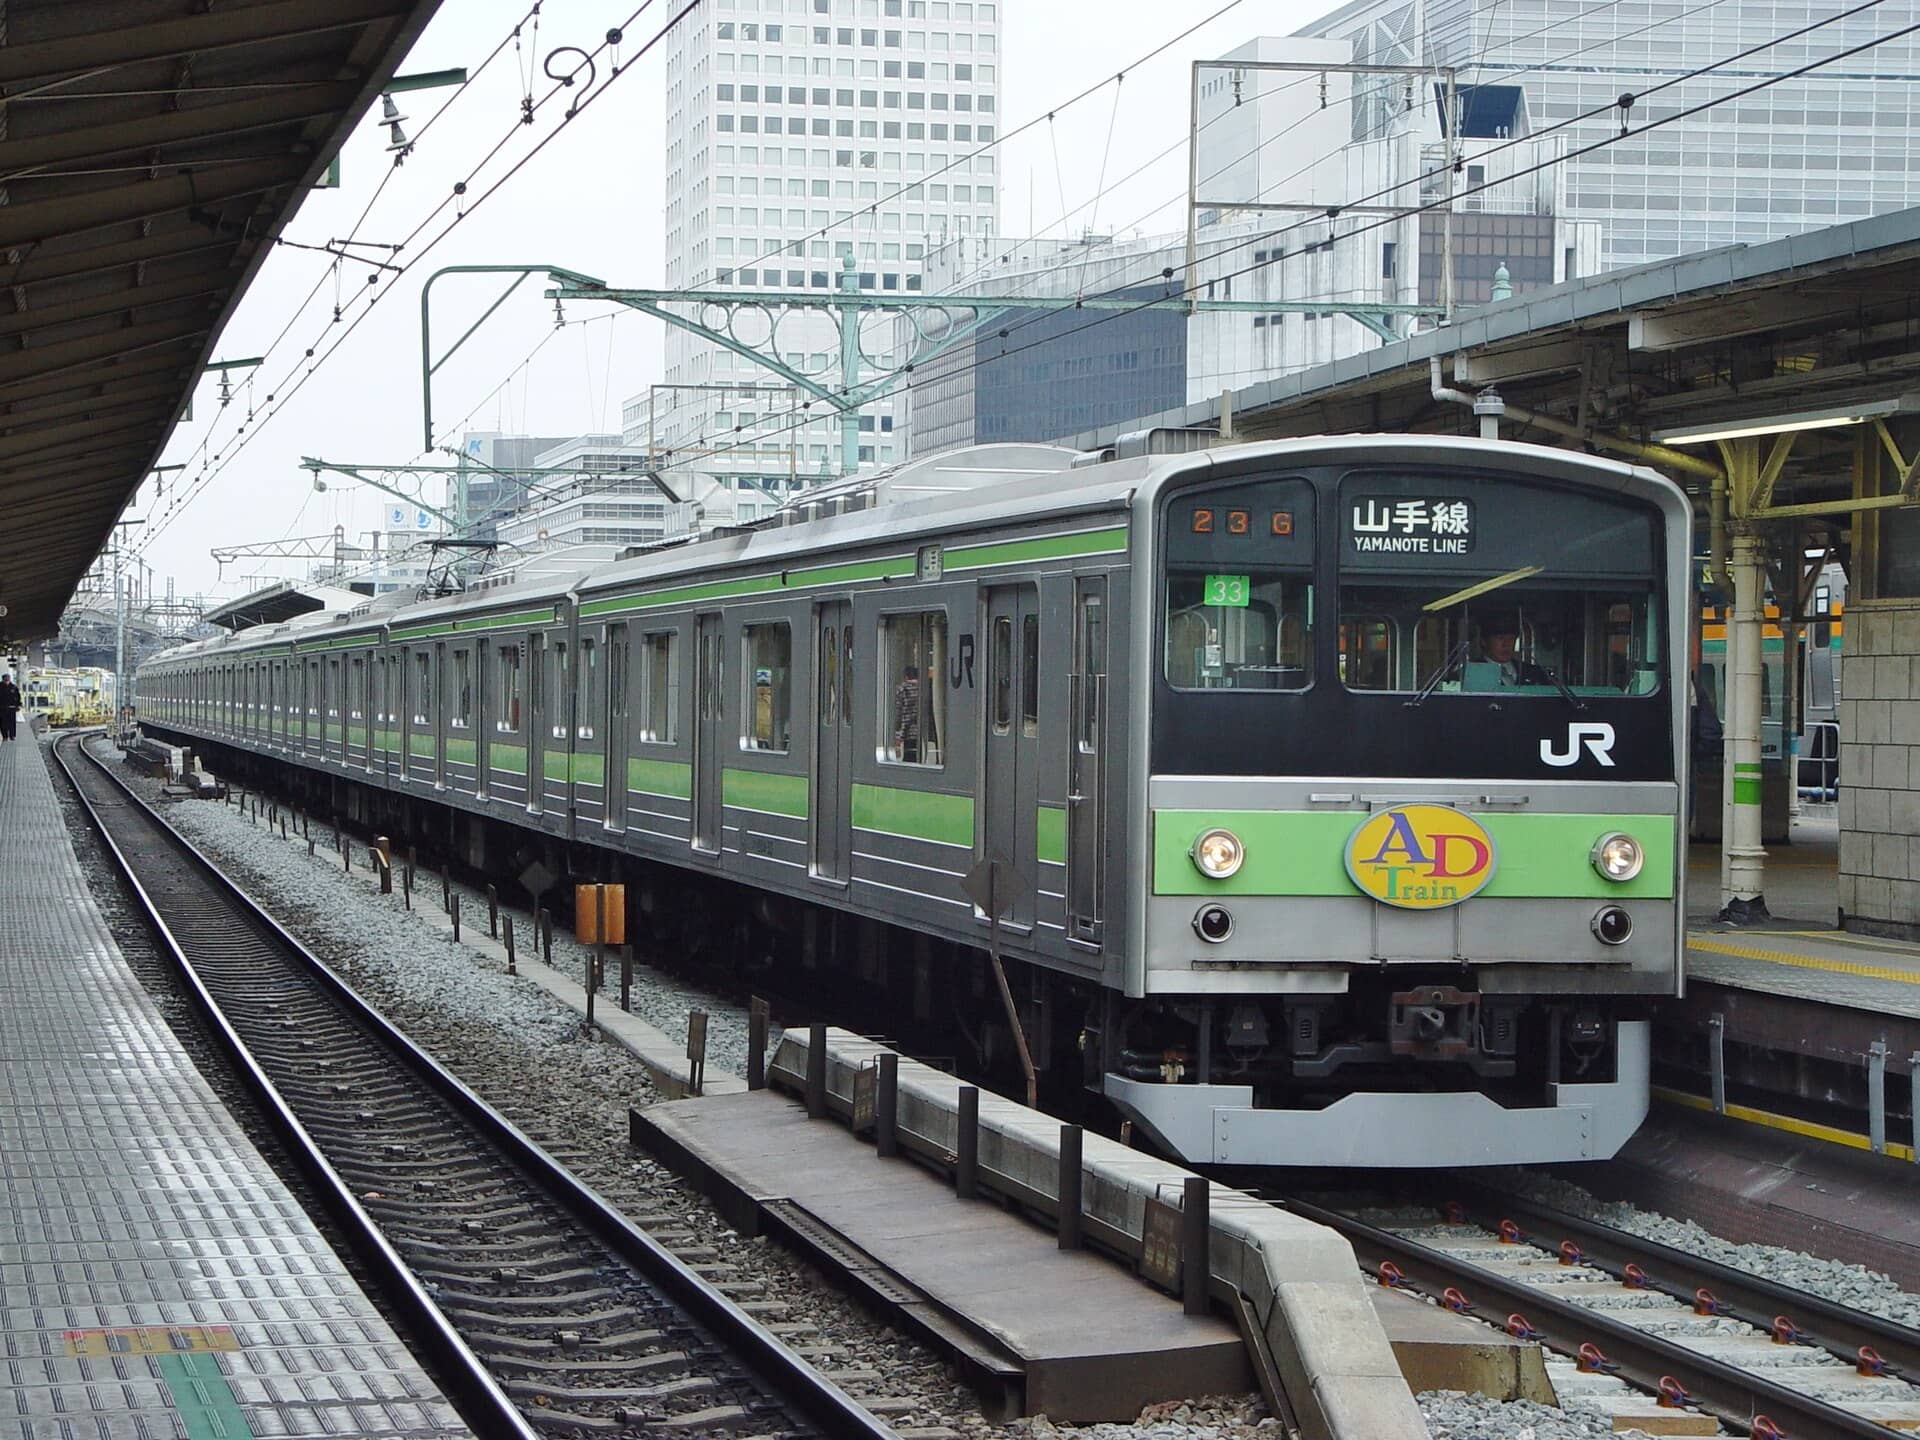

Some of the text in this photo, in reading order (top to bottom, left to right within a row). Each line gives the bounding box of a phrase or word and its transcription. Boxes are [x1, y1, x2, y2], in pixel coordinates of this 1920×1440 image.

[1352, 500, 1470, 535] 山手線
[1354, 536, 1467, 554] YAMANOTE LINE
[1212, 581, 1242, 603] 33
[951, 634, 974, 689] JR
[1540, 722, 1615, 766] JR
[1359, 812, 1489, 878] AD
[1373, 865, 1457, 900] Train
